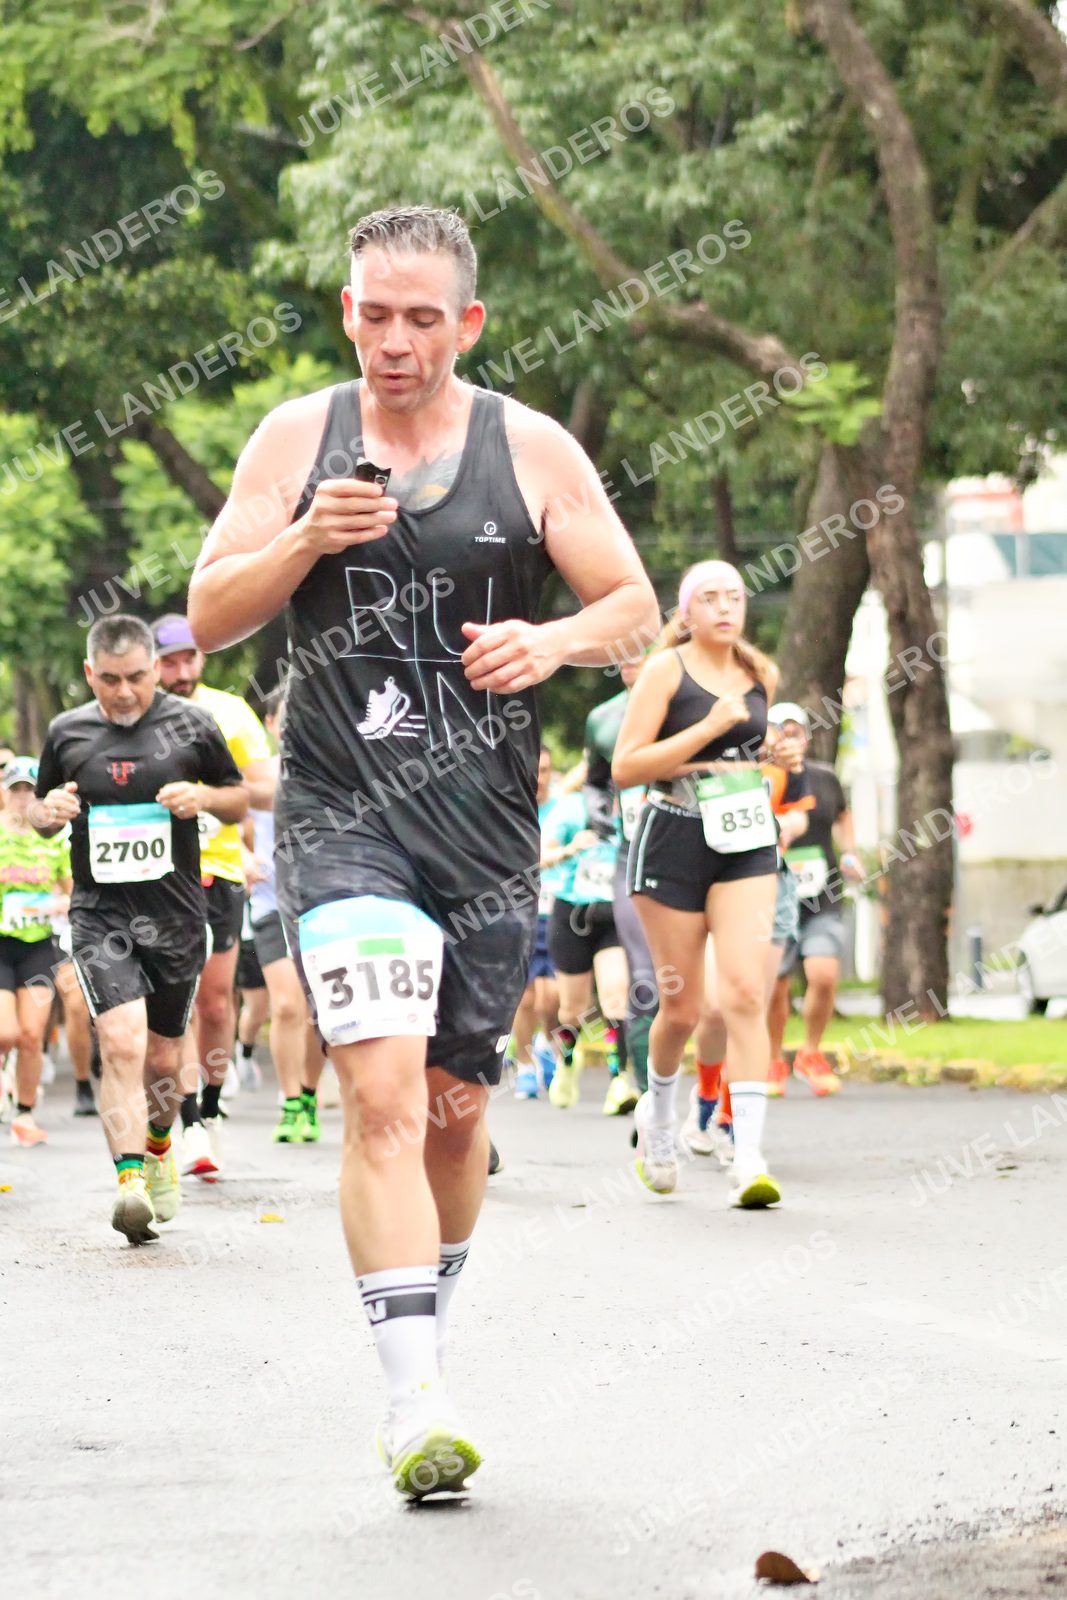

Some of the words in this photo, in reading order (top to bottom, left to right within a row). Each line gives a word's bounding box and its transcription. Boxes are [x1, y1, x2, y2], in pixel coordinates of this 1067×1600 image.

[474, 535, 507, 544] TOPTIME
[721, 805, 765, 833] 836
[96, 837, 166, 864] 2700
[321, 958, 435, 1011] 3185
